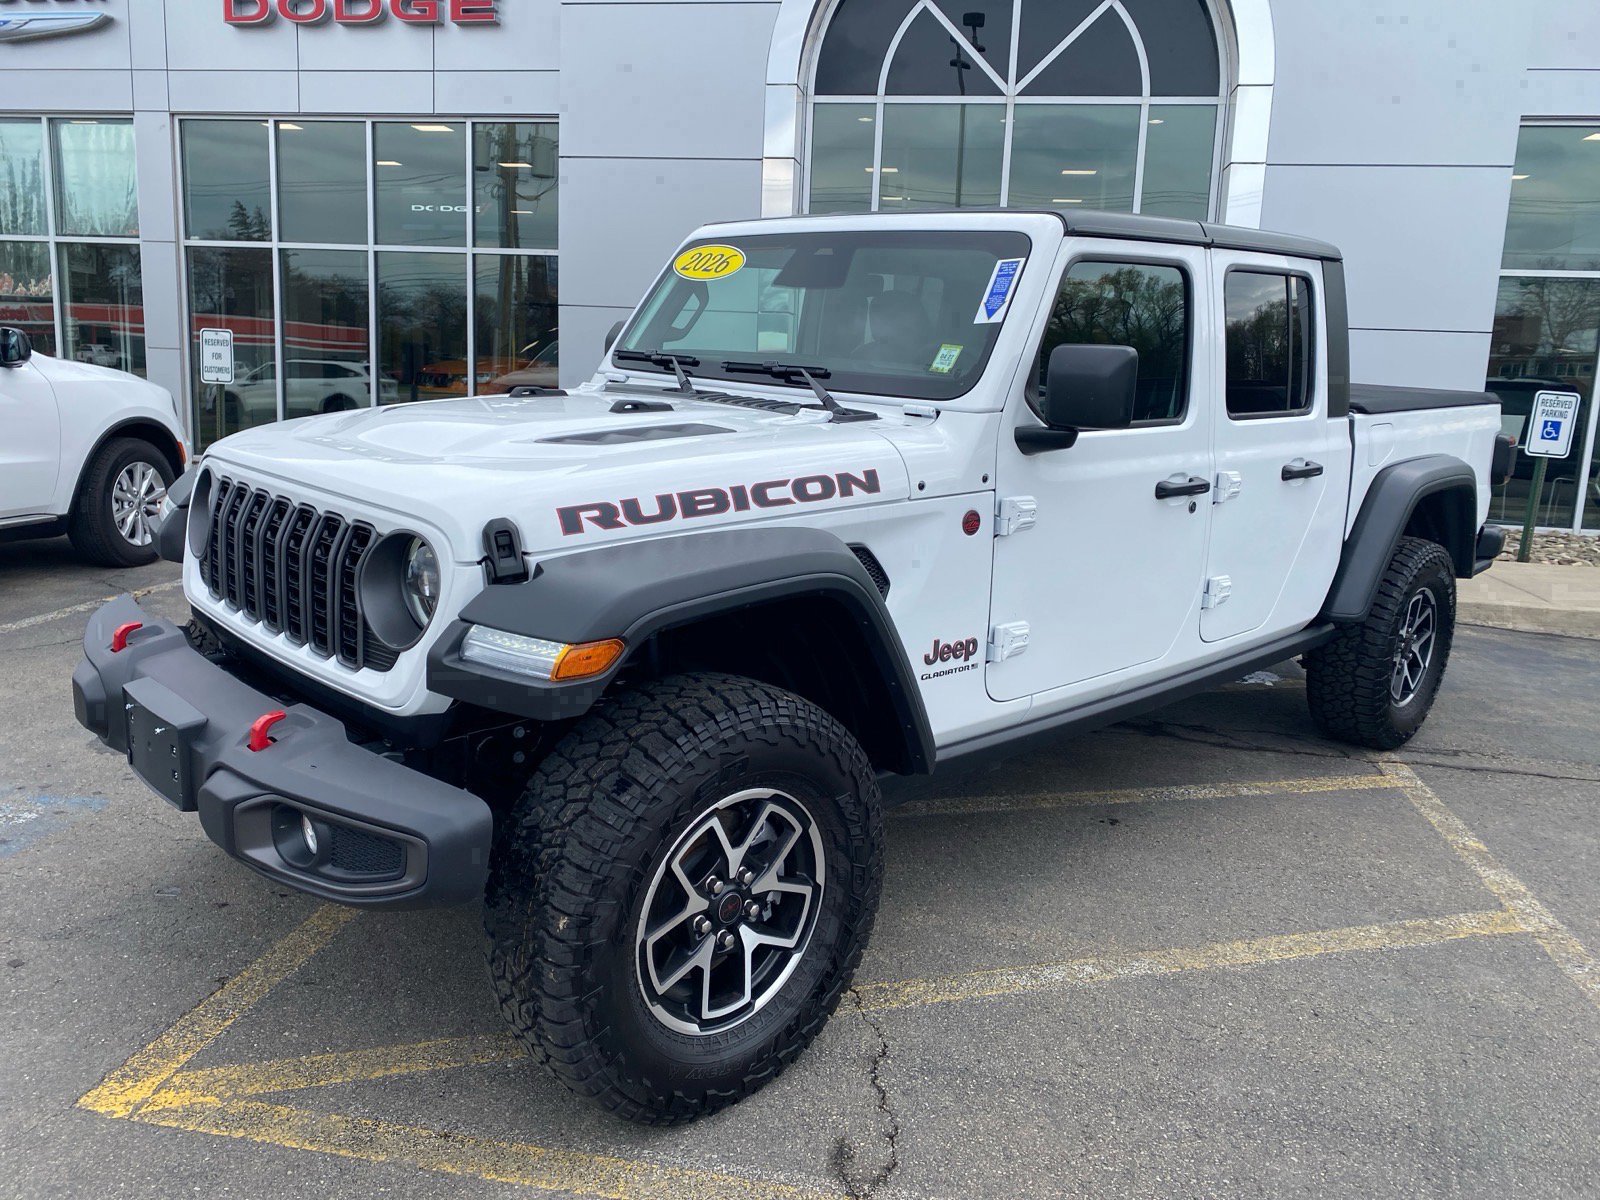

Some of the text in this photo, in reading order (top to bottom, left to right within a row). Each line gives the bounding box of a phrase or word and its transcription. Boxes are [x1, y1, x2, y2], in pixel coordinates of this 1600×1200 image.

[680, 252, 739, 274] 2026
[204, 338, 229, 346] RESERVED
[204, 366, 230, 374] CUSTOMERS
[1541, 398, 1573, 409] RESERVED
[1541, 409, 1568, 419] PARKING
[556, 468, 881, 536] RUBICON
[924, 637, 979, 666] Jeep
[921, 664, 970, 680] GLADIATOR
